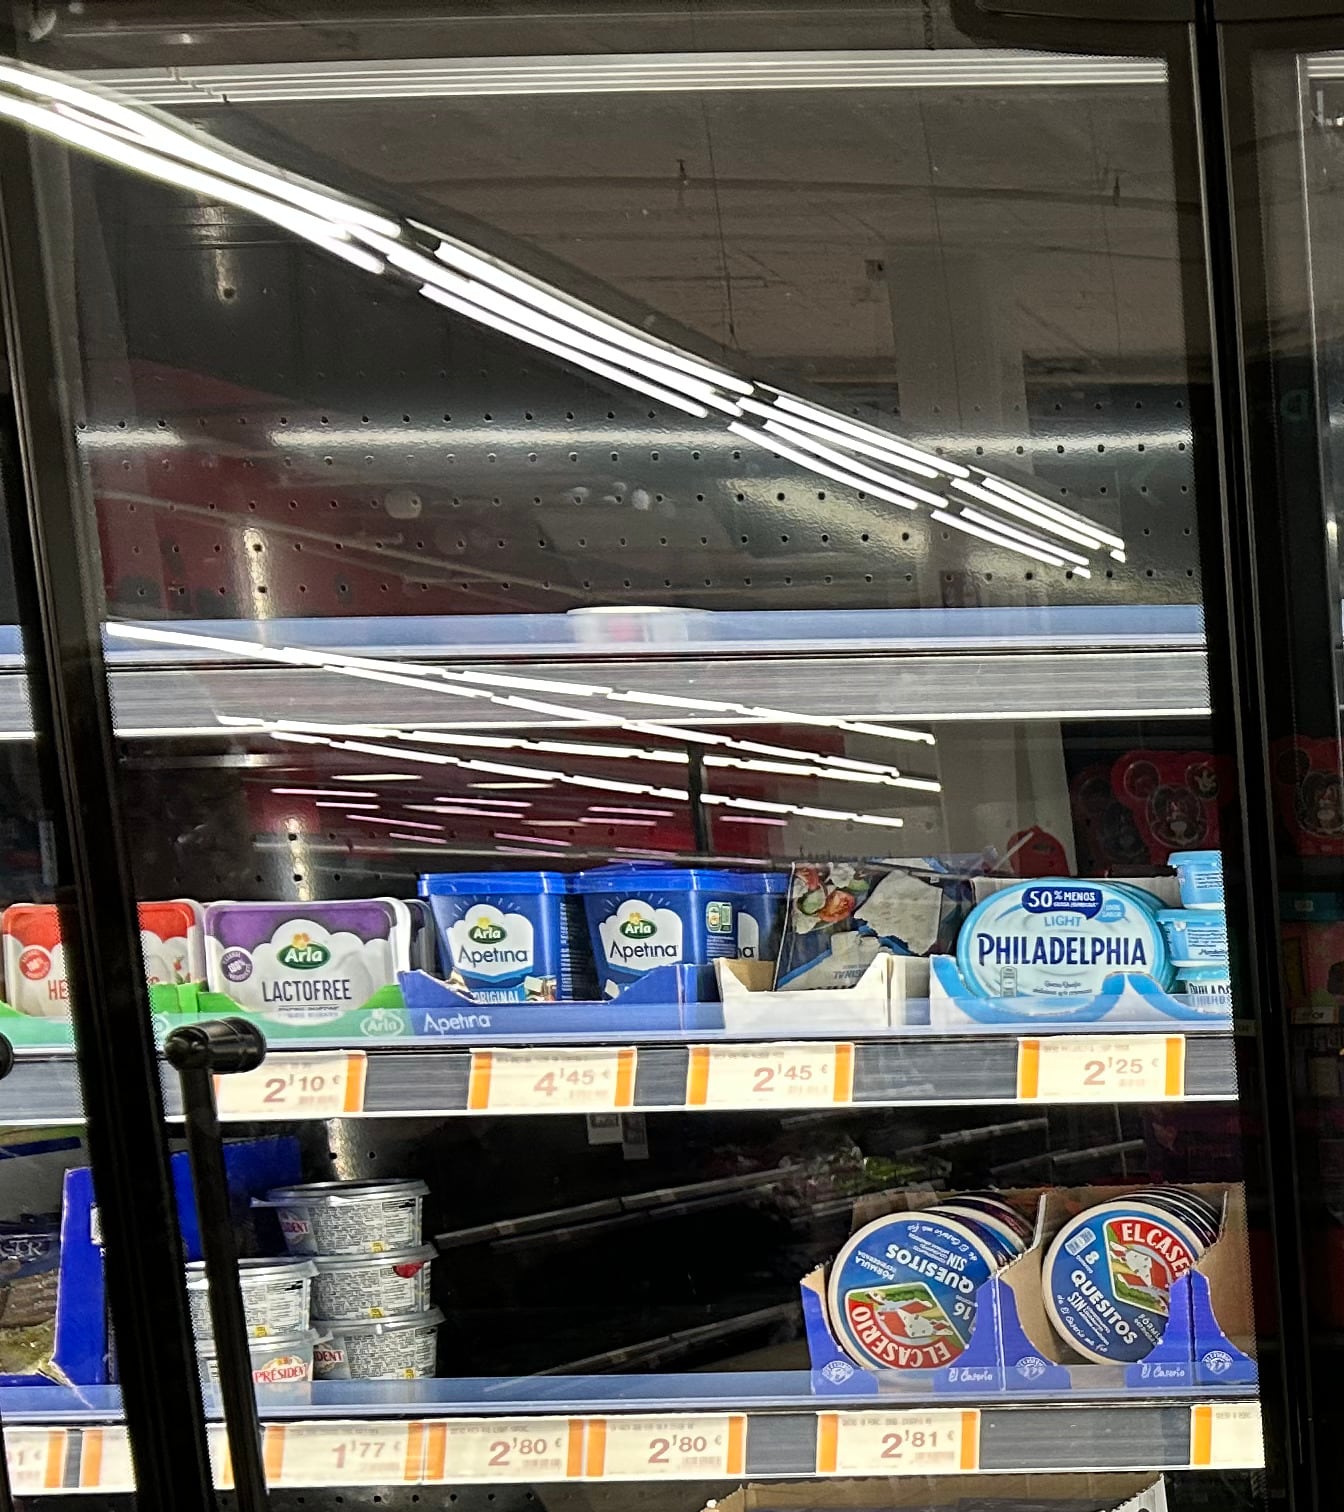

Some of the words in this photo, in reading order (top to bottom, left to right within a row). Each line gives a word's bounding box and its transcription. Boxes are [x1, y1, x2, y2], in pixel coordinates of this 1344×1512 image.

[1064, 891, 1096, 902] MENOS
[623, 922, 651, 936] Arla
[1044, 916, 1082, 927] LIGHT
[472, 927, 502, 940] Arla
[284, 948, 324, 964] Arla
[457, 941, 529, 964] Apetina
[609, 940, 678, 964] Apetina
[976, 933, 1147, 966] PHILADELPHIA
[262, 979, 352, 1002] LACTOFREE
[424, 1013, 491, 1033] Apetina
[949, 1252, 967, 1272] SIN
[1085, 1251, 1100, 1265] 8
[885, 1244, 974, 1294] QUESITOS
[1067, 1291, 1086, 1312] SIN
[1071, 1269, 1138, 1345] QUESITOS
[952, 1303, 972, 1321] 16
